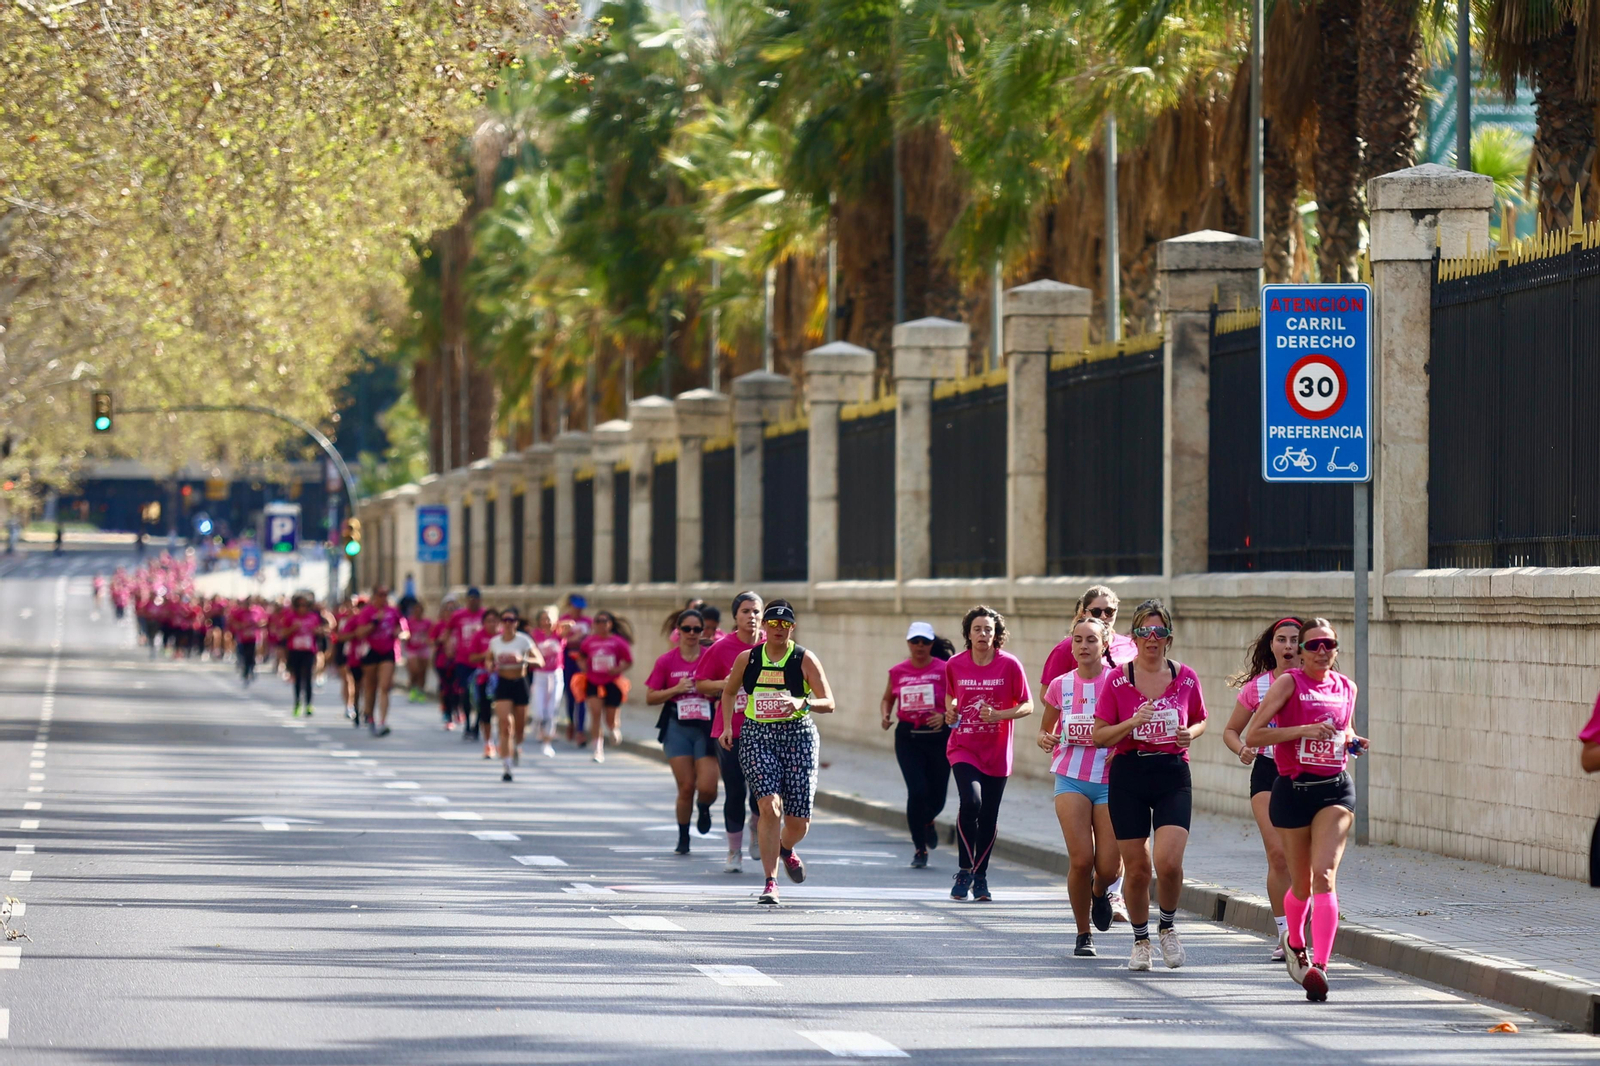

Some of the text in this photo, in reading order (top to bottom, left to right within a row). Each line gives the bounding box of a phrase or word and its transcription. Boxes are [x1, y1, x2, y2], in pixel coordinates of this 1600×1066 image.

[1269, 295, 1364, 312] ATENCIÓN
[1286, 317, 1346, 331] CARRIL
[1276, 335, 1356, 349] DERECHO
[1298, 376, 1334, 398] 30
[1269, 425, 1364, 439] PREFERENCIA
[271, 517, 293, 543] P
[982, 678, 1005, 686] MUJERES
[757, 700, 779, 710] 3588
[1138, 721, 1164, 736] 2371
[1310, 740, 1331, 754] 632
